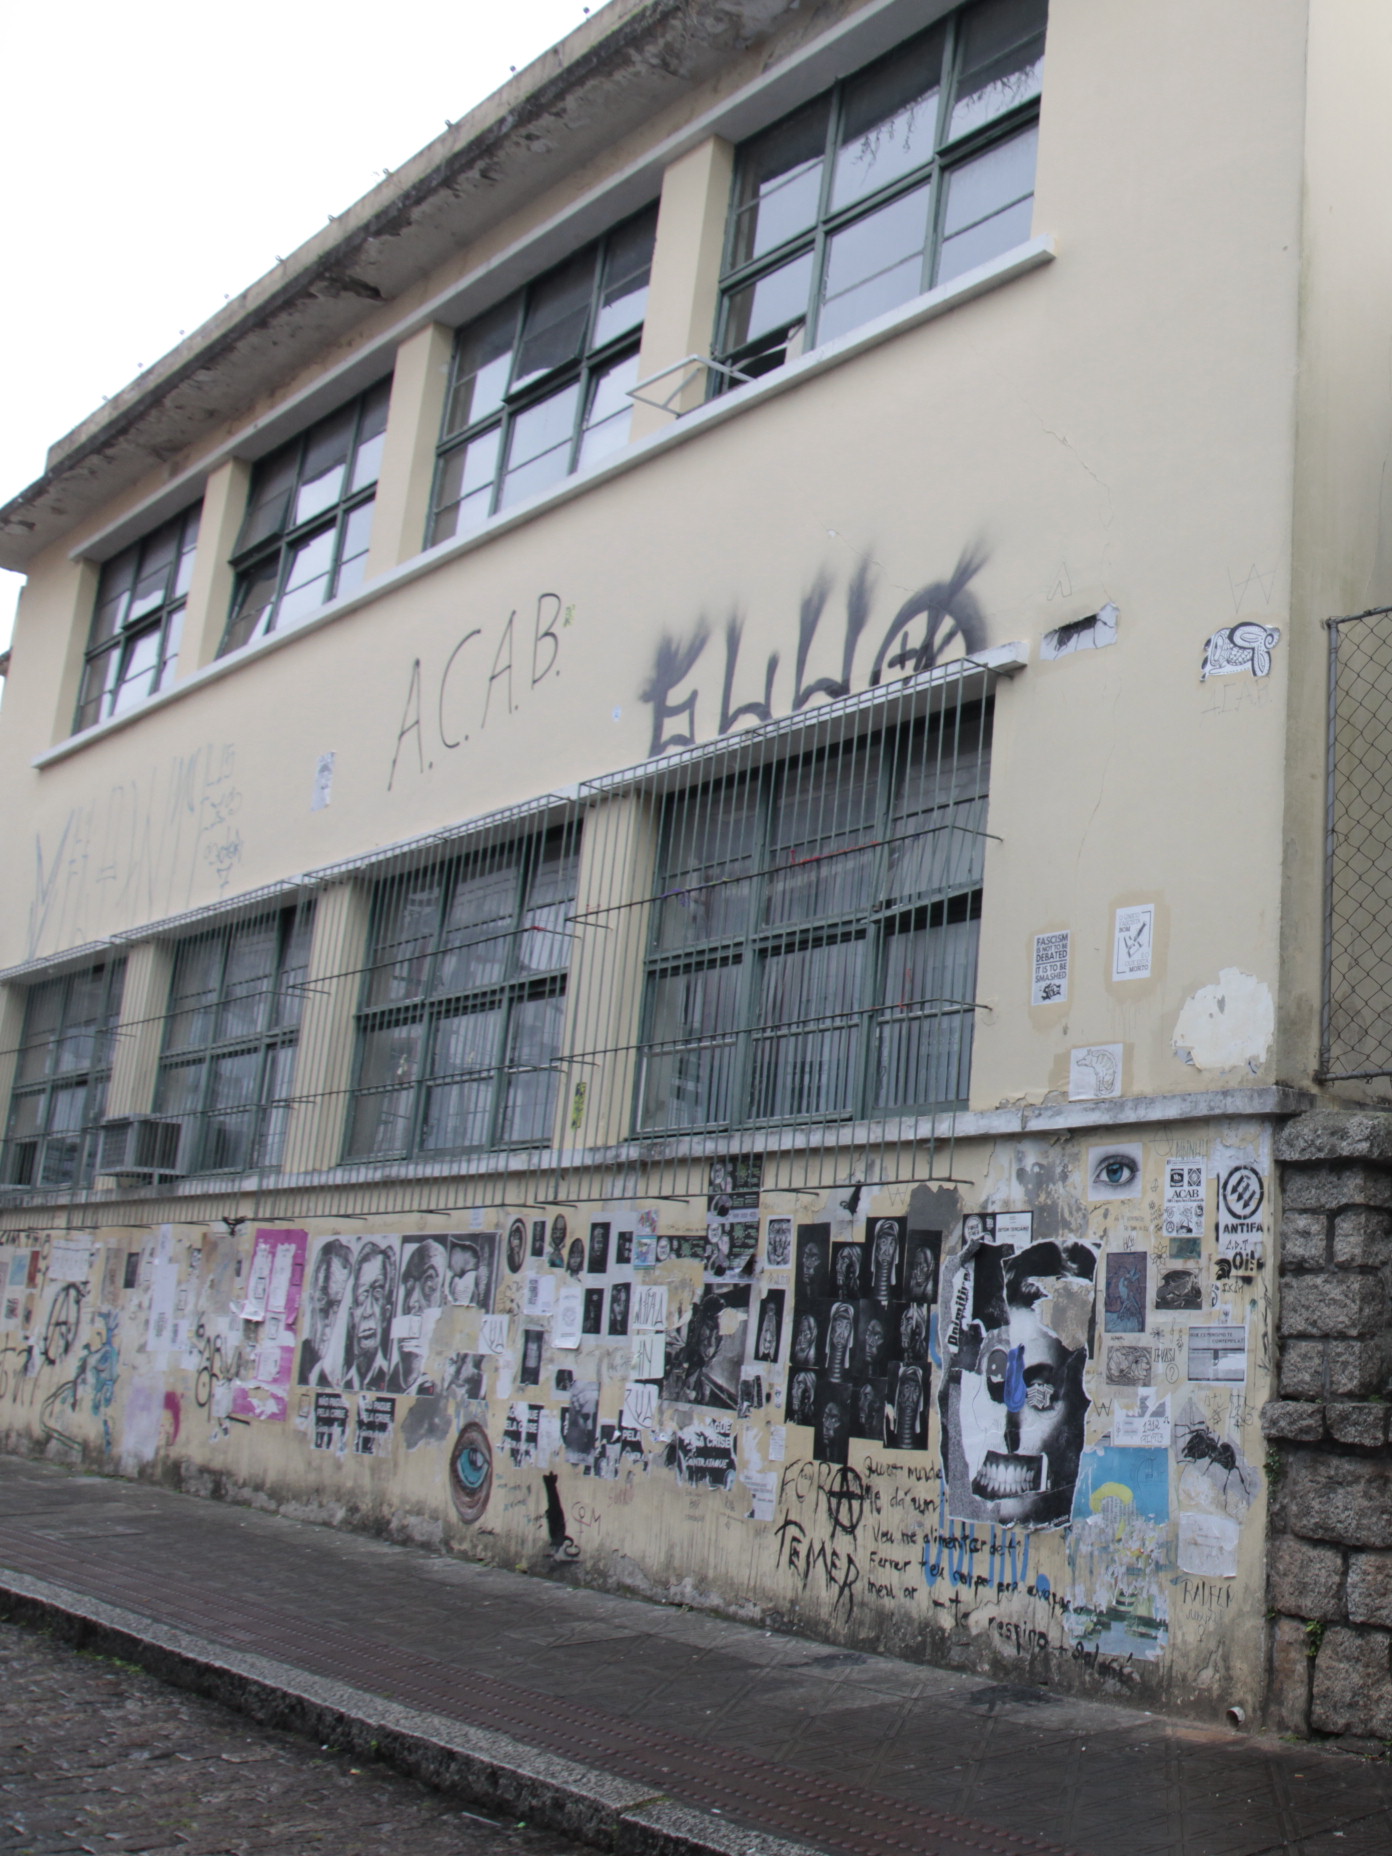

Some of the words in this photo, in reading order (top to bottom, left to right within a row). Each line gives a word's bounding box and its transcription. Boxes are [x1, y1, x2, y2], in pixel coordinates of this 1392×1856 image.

[1036, 933, 1068, 946] FASCISM
[1041, 944, 1053, 953] NOT
[1036, 949, 1068, 962] DEBATED
[1059, 962, 1067, 971] BE
[1035, 971, 1067, 983] SMASHED
[1172, 1189, 1200, 1198] ACAB
[1223, 1223, 1264, 1234] ANTIFA
[622, 1429, 642, 1441] PELA
[706, 1436, 732, 1448] CRISE
[775, 1508, 860, 1624] TEMER
